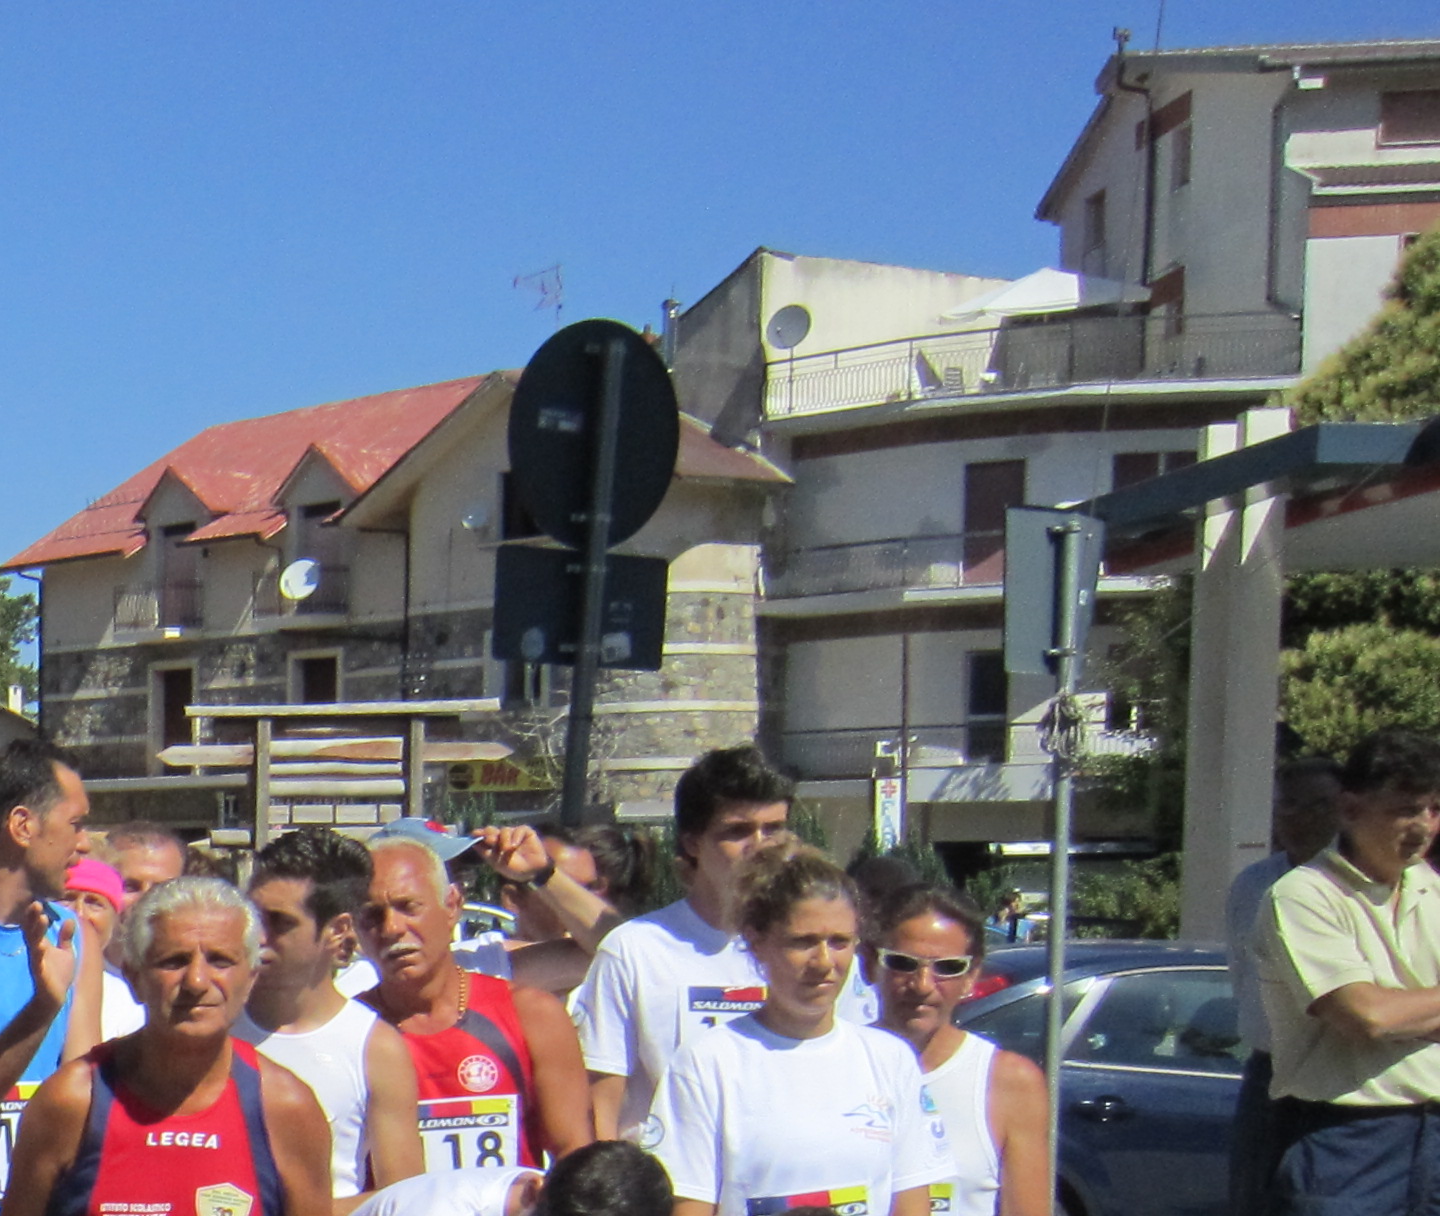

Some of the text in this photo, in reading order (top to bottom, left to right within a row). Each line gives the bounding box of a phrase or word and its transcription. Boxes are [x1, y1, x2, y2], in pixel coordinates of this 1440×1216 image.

[482, 763, 520, 785] BAR
[419, 1117, 476, 1128] LOMON
[146, 1132, 219, 1149] LEGEA
[422, 1131, 506, 1169] 18
